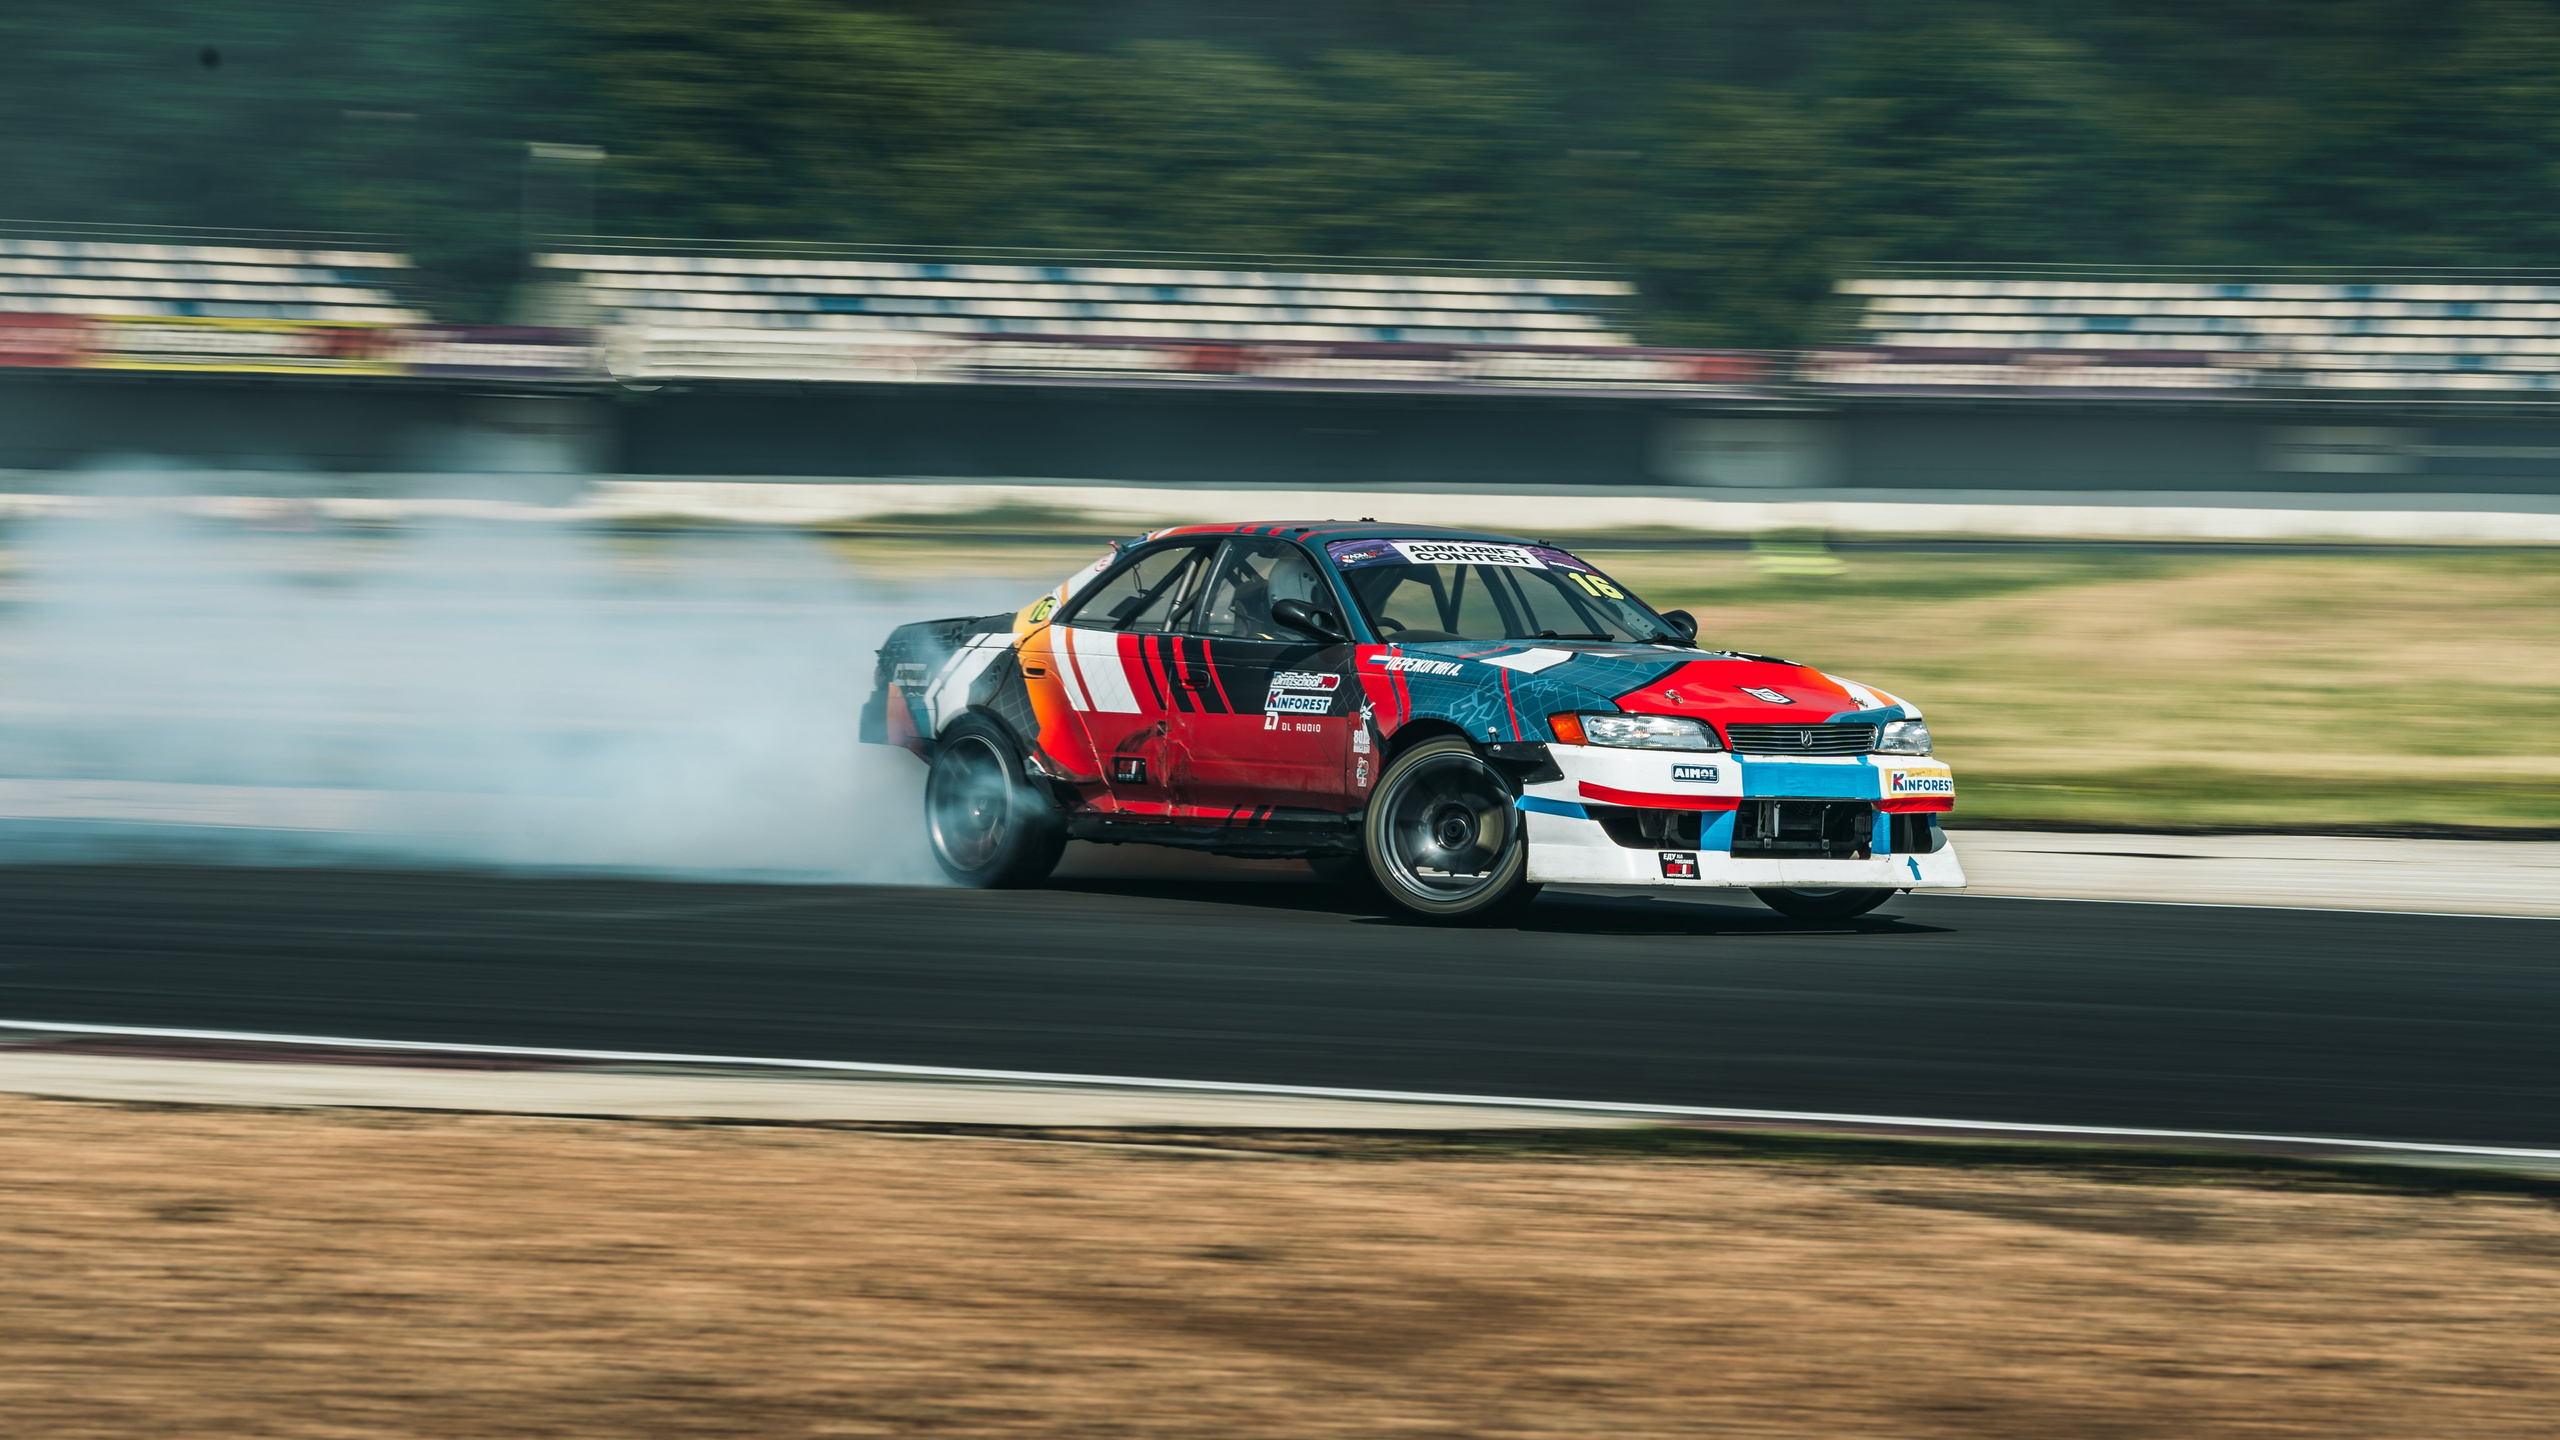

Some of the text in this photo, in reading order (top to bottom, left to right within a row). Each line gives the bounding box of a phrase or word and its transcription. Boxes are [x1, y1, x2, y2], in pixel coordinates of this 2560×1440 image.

[1408, 545, 1521, 556] ADM DRIFT
[1415, 553, 1531, 565] CONTEST
[1568, 572, 1625, 600] 16
[1030, 599, 1057, 621] 16
[1385, 656, 1455, 675] ПЕРЕЖОГИН
[1267, 690, 1330, 711] KINFOREST
[1281, 722, 1321, 733] DL AUDIO
[1674, 767, 1717, 780] AIMOL
[1892, 773, 1953, 791] KINFOREST
[1663, 853, 1677, 861] ЕДУ
